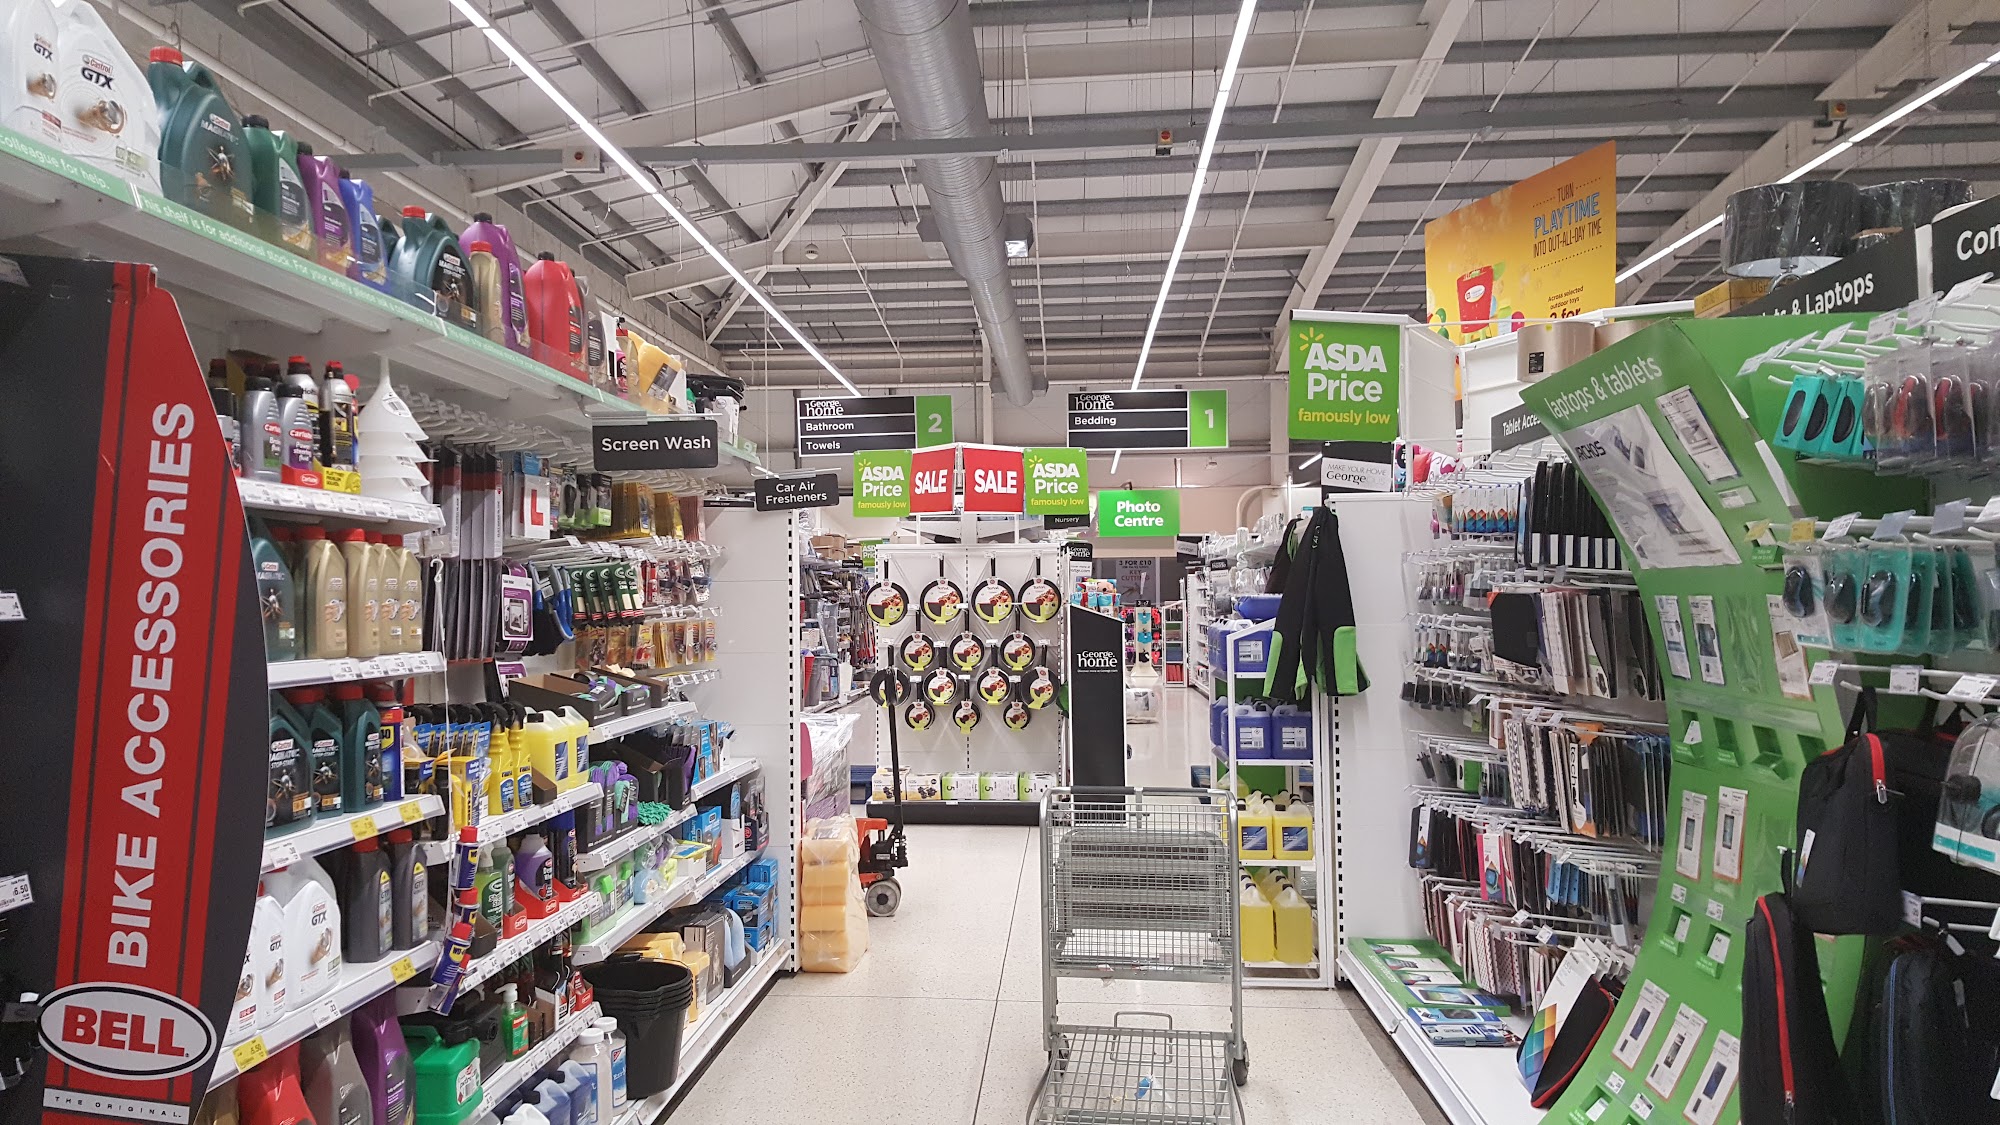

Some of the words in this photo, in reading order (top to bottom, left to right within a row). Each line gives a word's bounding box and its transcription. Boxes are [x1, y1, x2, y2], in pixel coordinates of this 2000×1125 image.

[34, 43, 53, 61] GTX
[81, 67, 114, 90] GTX
[1557, 183, 1574, 202] TURN
[1533, 192, 1600, 239] PLAYTIME
[1533, 240, 1547, 258] INTO
[1548, 223, 1586, 254] OUT-ALL-DAY
[1588, 218, 1602, 238] TIME
[1805, 272, 1875, 314] Laptops
[1304, 343, 1387, 372] ASDA
[1308, 373, 1383, 402] Price
[1544, 386, 1596, 420] laptops
[1590, 377, 1608, 401] &
[1603, 354, 1663, 393] tablets
[805, 404, 844, 416] home
[1074, 397, 1114, 410] home
[928, 414, 942, 432] 2
[1074, 416, 1116, 426] Bedding
[1204, 409, 1214, 428] 1
[1298, 408, 1362, 426] famously
[1366, 410, 1390, 424] low
[1502, 415, 1521, 436] Tablet
[806, 422, 854, 432] Bathroom
[602, 436, 660, 452] Screen
[664, 435, 712, 450] Wash
[806, 441, 841, 450] Towels
[860, 466, 904, 482] ASDA
[1032, 462, 1080, 478] ASDA
[1328, 464, 1346, 472] MAKE
[1348, 465, 1368, 474] YOUR
[1368, 467, 1386, 476] HOME
[776, 483, 796, 494] Car
[798, 481, 816, 492] Air
[862, 482, 902, 497] Price
[914, 470, 948, 494] SALE
[974, 468, 1018, 494] SALE
[1034, 478, 1078, 494] Price
[766, 492, 828, 504] Fresheners
[858, 501, 891, 510] famously
[1030, 497, 1067, 507] famously
[1069, 497, 1084, 506] low
[1116, 500, 1161, 512] Photo
[530, 489, 544, 526] L
[1114, 515, 1164, 528] Centre
[121, 402, 194, 818] ACCESSORIES
[1076, 654, 1118, 668] home
[108, 833, 158, 968] BIKE
[311, 912, 328, 926] GTX
[62, 1004, 185, 1058] BELL
[54, 1096, 84, 1106] THE
